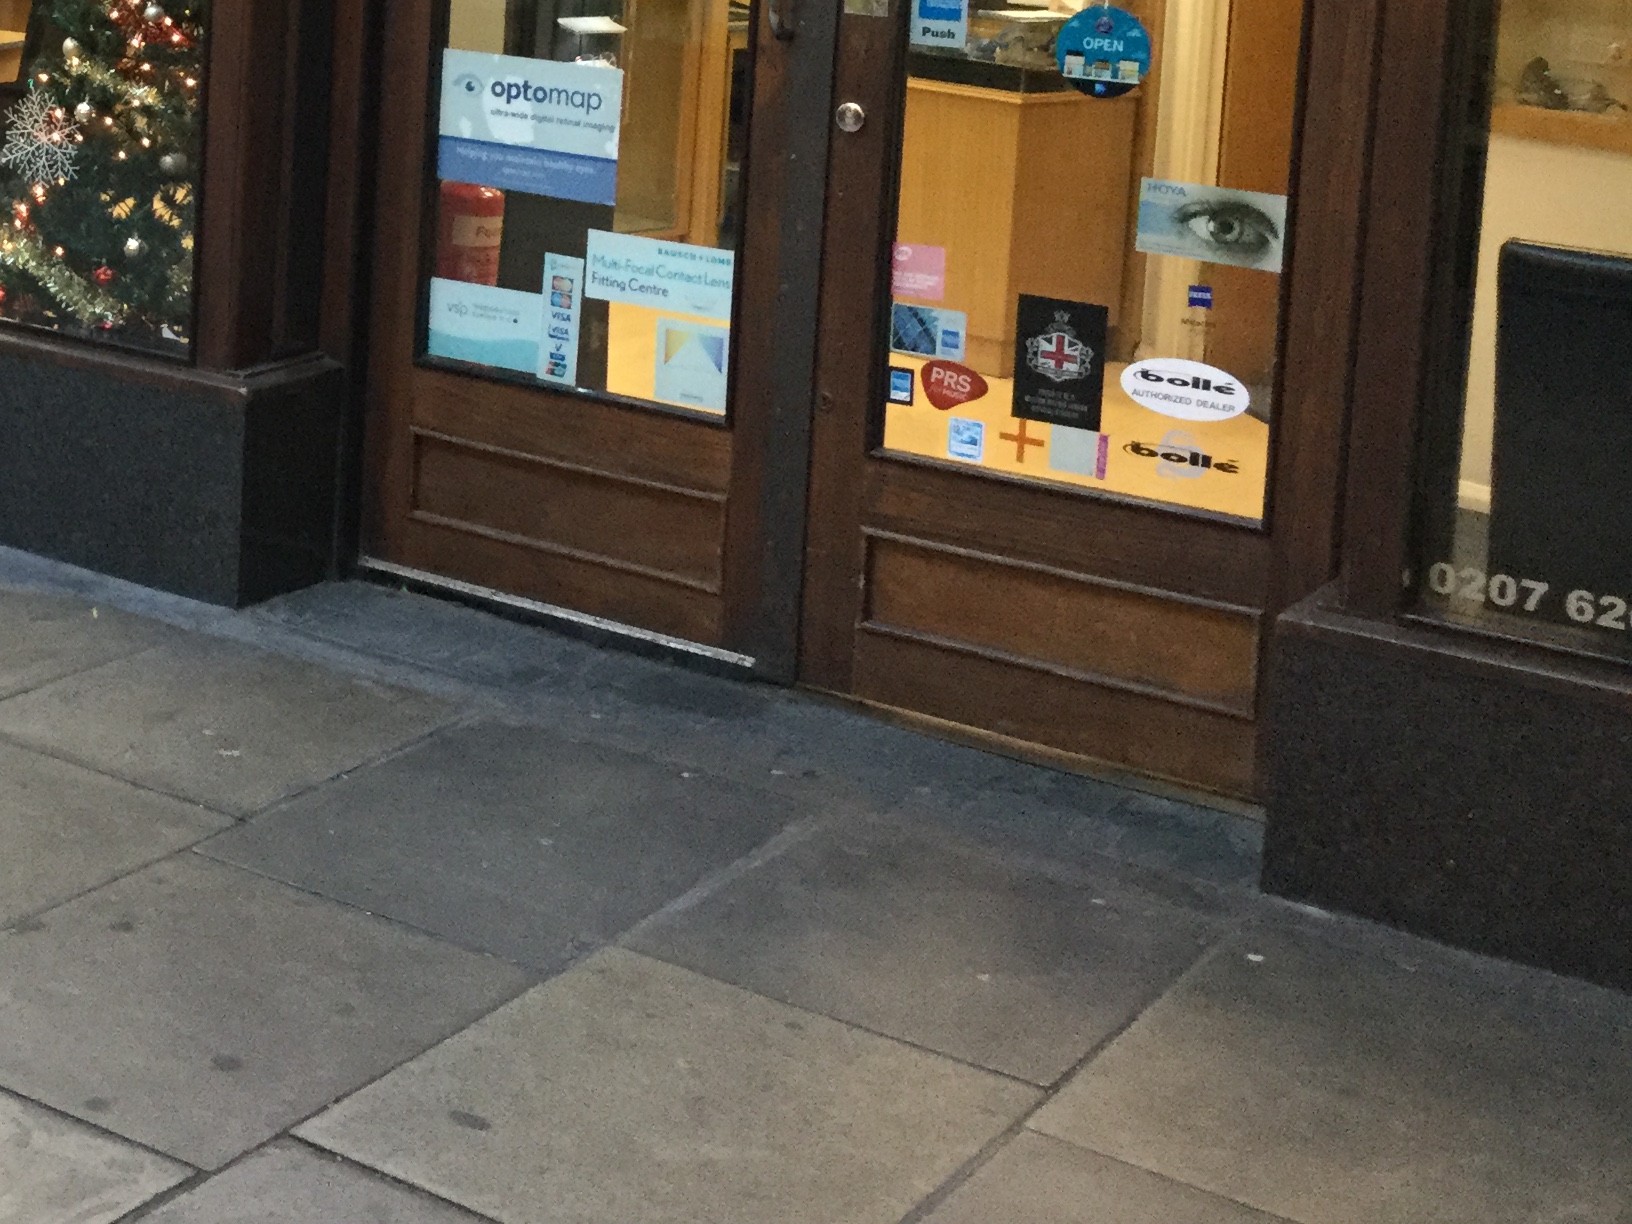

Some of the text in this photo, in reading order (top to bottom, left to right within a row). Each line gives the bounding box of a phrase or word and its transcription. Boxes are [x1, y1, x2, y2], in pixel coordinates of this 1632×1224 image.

[921, 26, 956, 40] Push
[1082, 36, 1124, 52] OPEN
[491, 79, 603, 116] optomap
[530, 112, 555, 124] digital
[1147, 182, 1187, 197] HOYA
[591, 253, 655, 276] Multi-Focal
[656, 264, 703, 286] Contact
[704, 271, 730, 290] Lens
[591, 270, 669, 298] Fitting Centre
[551, 311, 572, 323] VISA
[930, 366, 972, 393] PRS
[1133, 368, 1236, 396] bollé
[1131, 388, 1236, 413] AUTHORIZED DEALER
[1123, 440, 1240, 474] bollé
[1429, 561, 1632, 631] 0207 62
